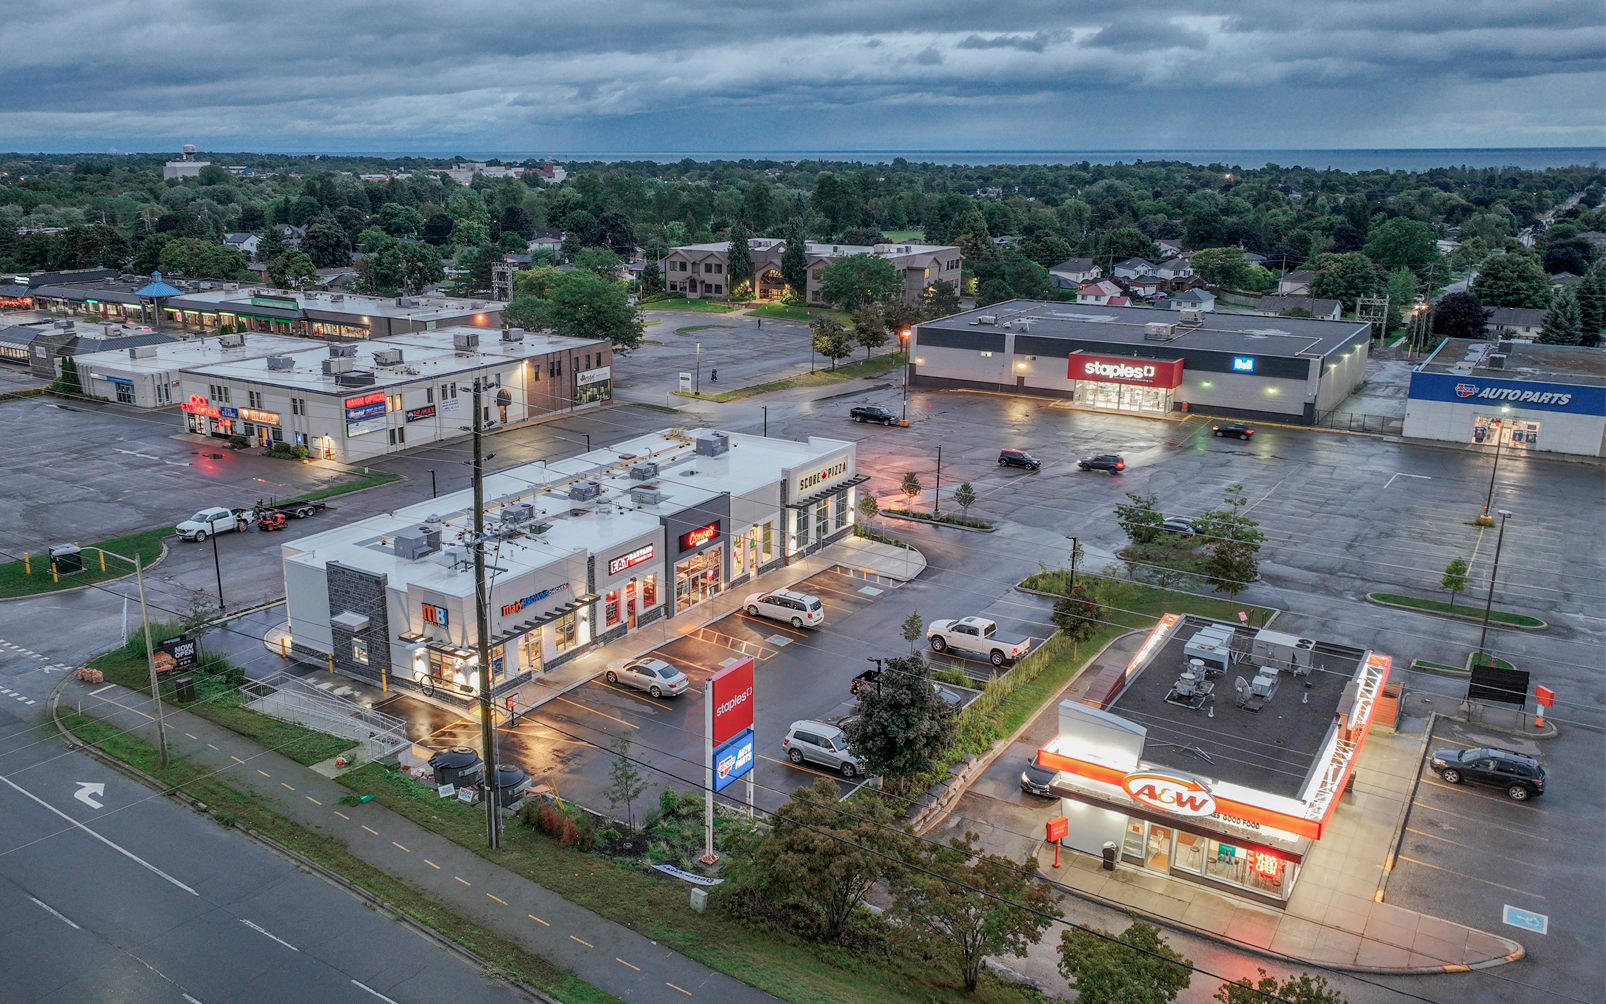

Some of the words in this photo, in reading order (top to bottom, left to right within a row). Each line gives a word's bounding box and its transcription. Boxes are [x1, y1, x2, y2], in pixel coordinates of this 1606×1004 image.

[1085, 360, 1144, 379] staples
[365, 392, 386, 405] OPTICAL
[250, 410, 277, 422] RE/MAX
[412, 406, 435, 417] RE/MAX
[800, 472, 821, 490] SCORE
[827, 461, 846, 478] PIZZA
[610, 555, 629, 574] FAT
[174, 642, 194, 652] NOW
[174, 648, 194, 658] OPEN
[716, 691, 747, 717] staples
[1133, 783, 1209, 812] A&W
[1222, 814, 1241, 824] GOOD
[1243, 819, 1260, 829] FOOD
